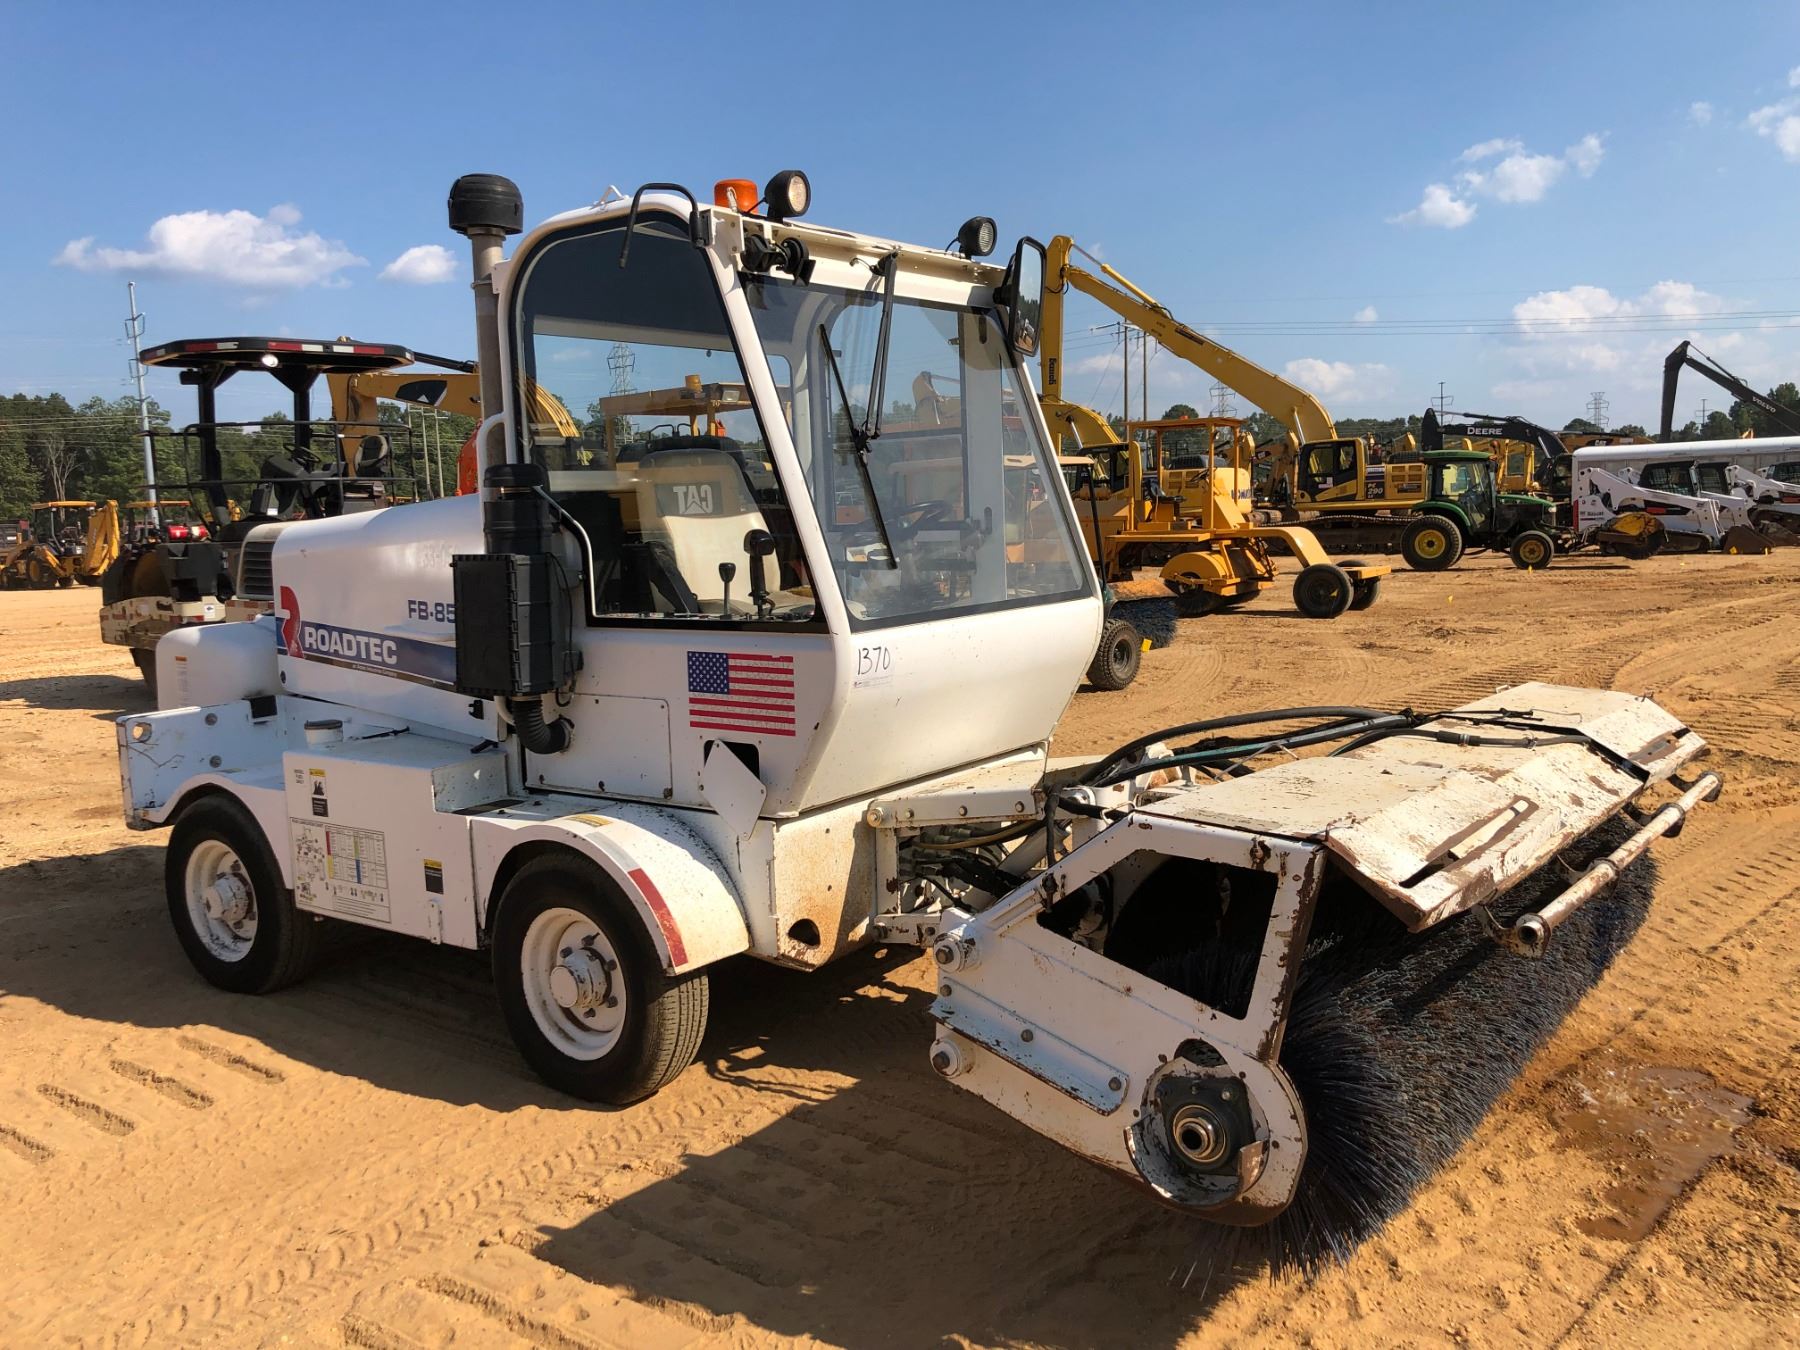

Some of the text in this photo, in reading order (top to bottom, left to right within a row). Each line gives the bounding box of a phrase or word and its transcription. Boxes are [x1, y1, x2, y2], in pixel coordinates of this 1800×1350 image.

[1752, 396, 1776, 413] VOLVO
[1467, 426, 1503, 435] DEERE
[304, 626, 398, 665] ROADTEC
[857, 646, 891, 676] 1370
